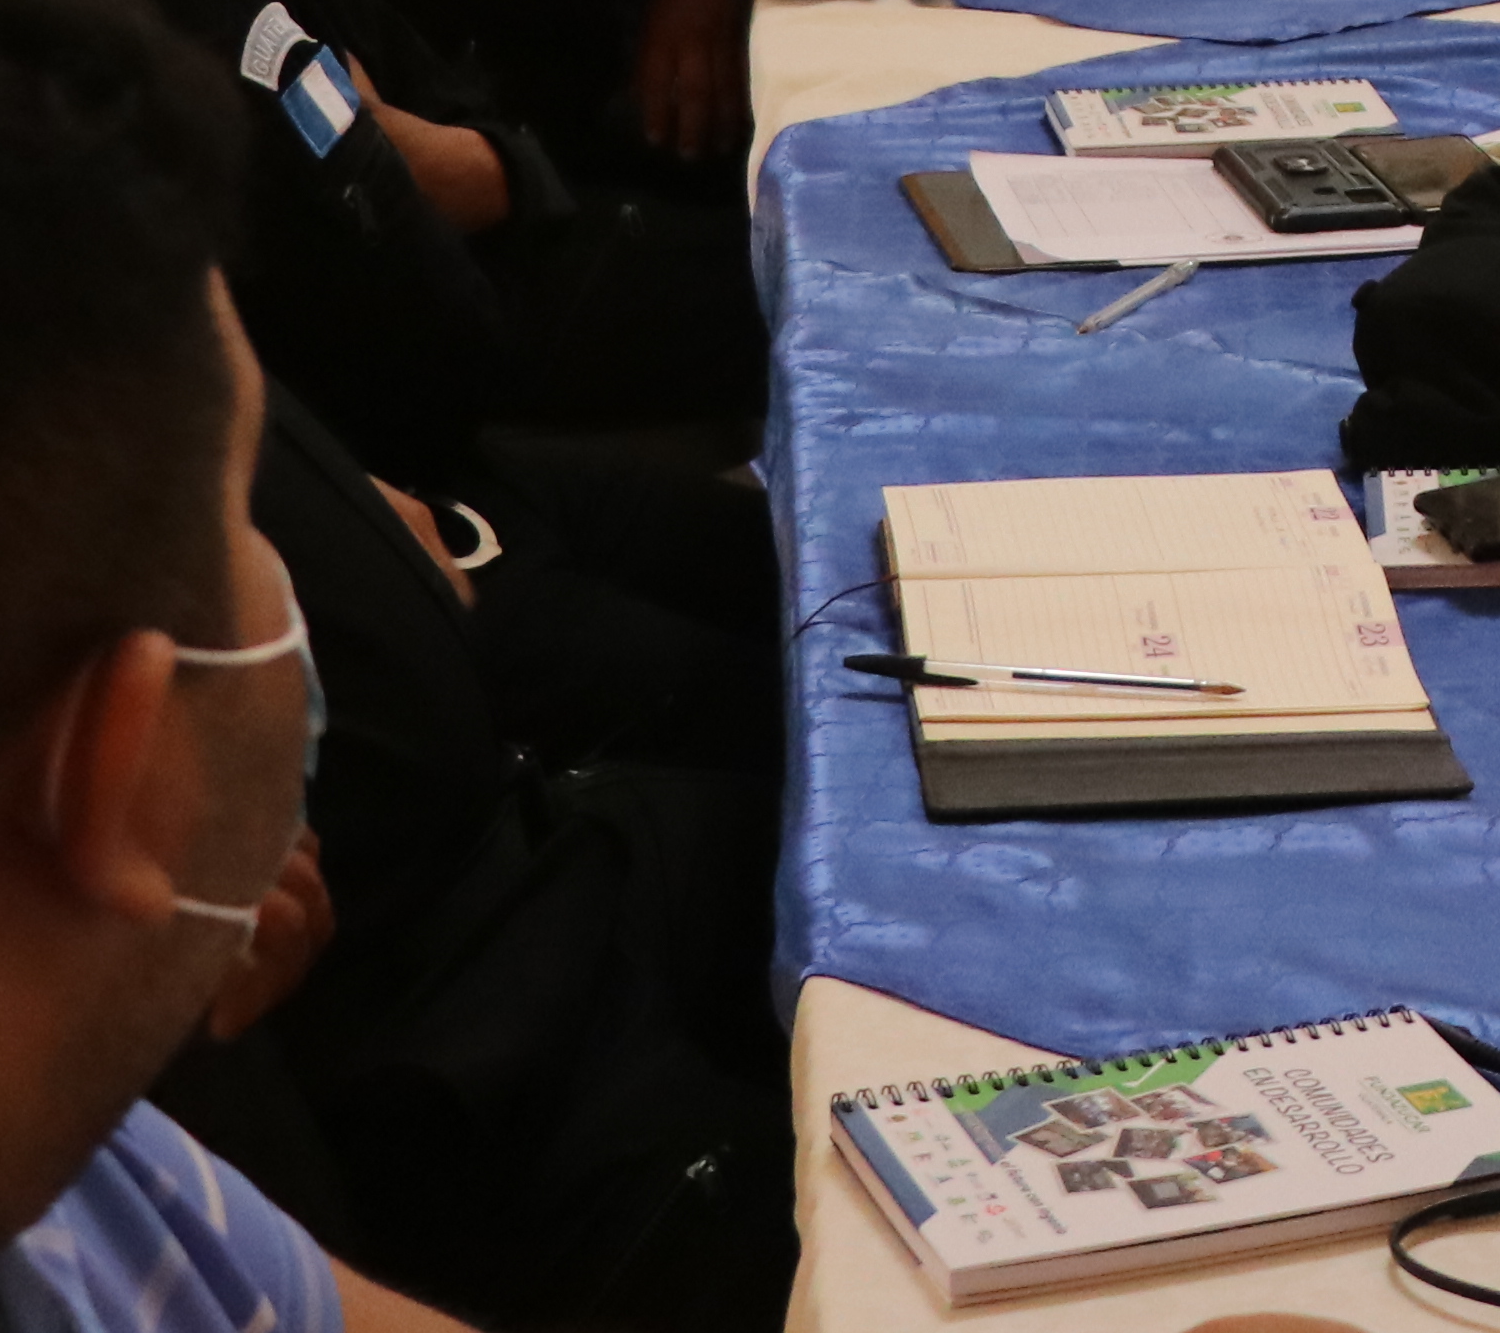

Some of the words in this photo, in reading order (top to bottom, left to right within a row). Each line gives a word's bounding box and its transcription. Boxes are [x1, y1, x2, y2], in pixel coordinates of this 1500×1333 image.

[1142, 634, 1175, 659] 24
[1357, 623, 1390, 647] 23
[1243, 1067, 1276, 1087] EN
[1260, 1082, 1365, 1175] DESARROLLO
[1284, 1068, 1395, 1163] COMUNIDADES
